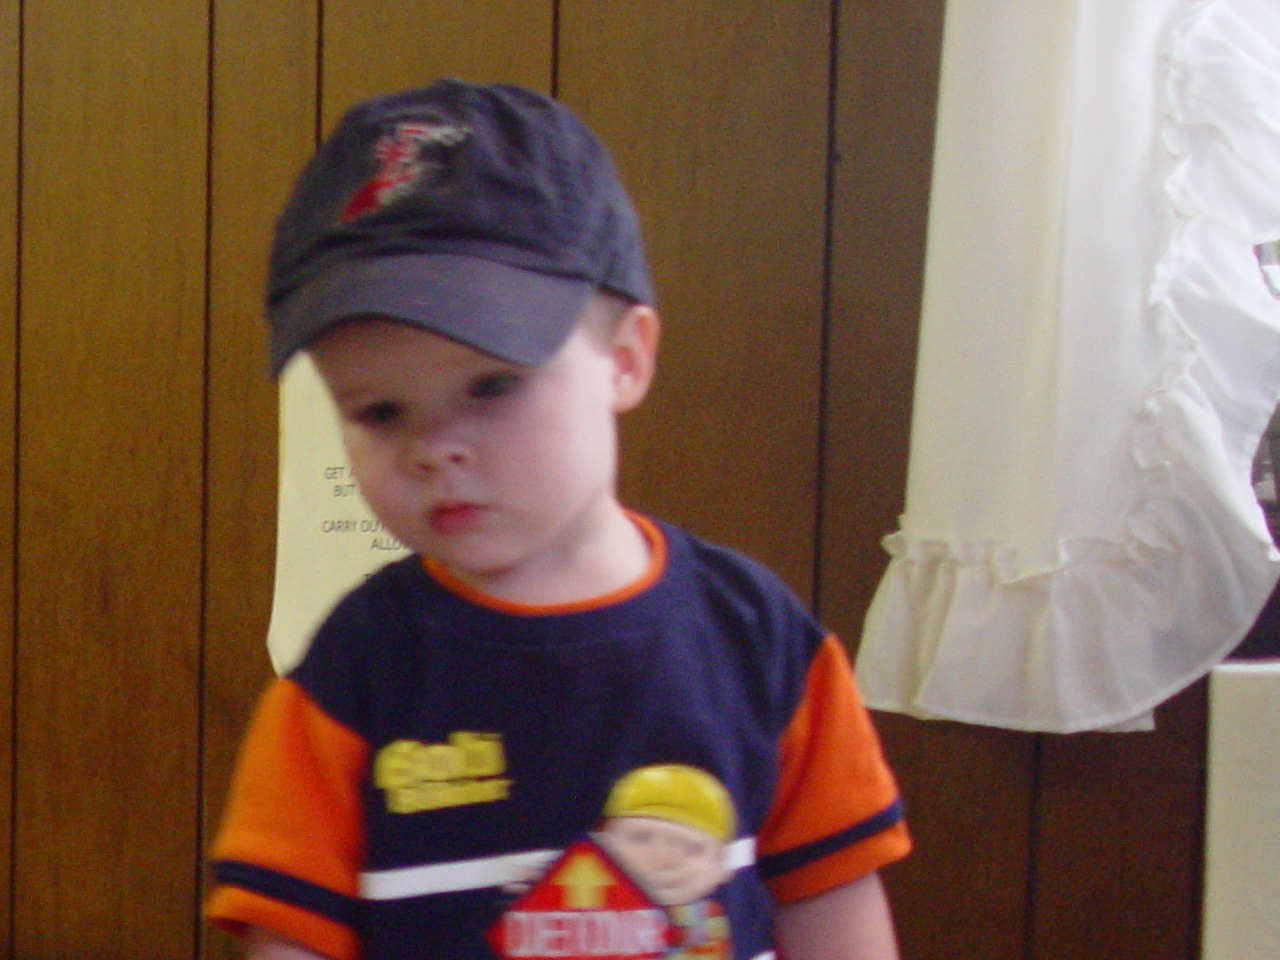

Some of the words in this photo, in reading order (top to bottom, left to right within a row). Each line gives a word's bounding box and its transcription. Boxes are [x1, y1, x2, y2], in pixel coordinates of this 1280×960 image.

[324, 467, 345, 479] GET
[334, 485, 356, 497] BUT
[322, 520, 358, 533] CARRY
